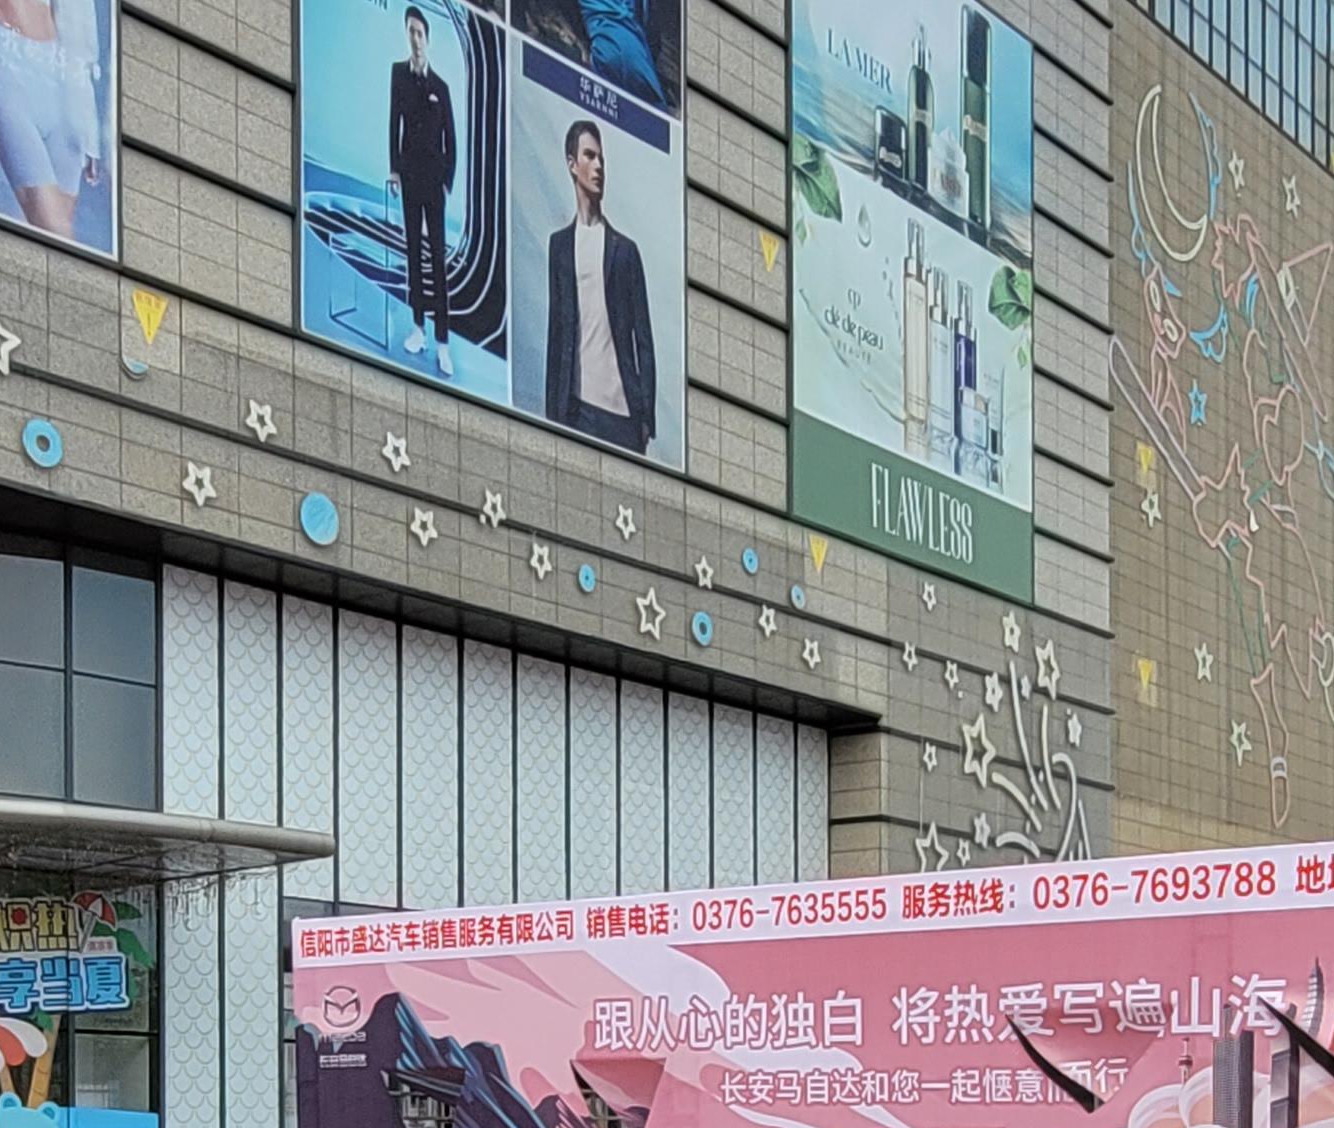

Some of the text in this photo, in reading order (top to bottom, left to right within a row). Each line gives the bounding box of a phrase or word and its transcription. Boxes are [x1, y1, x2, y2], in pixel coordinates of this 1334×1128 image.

[871, 462, 973, 564] FLAWLESS
[300, 909, 575, 958] 信阳市盛达汽车销售服务有限公司
[593, 973, 1288, 1051] 跟从心的独白 将热爱写遍山海
